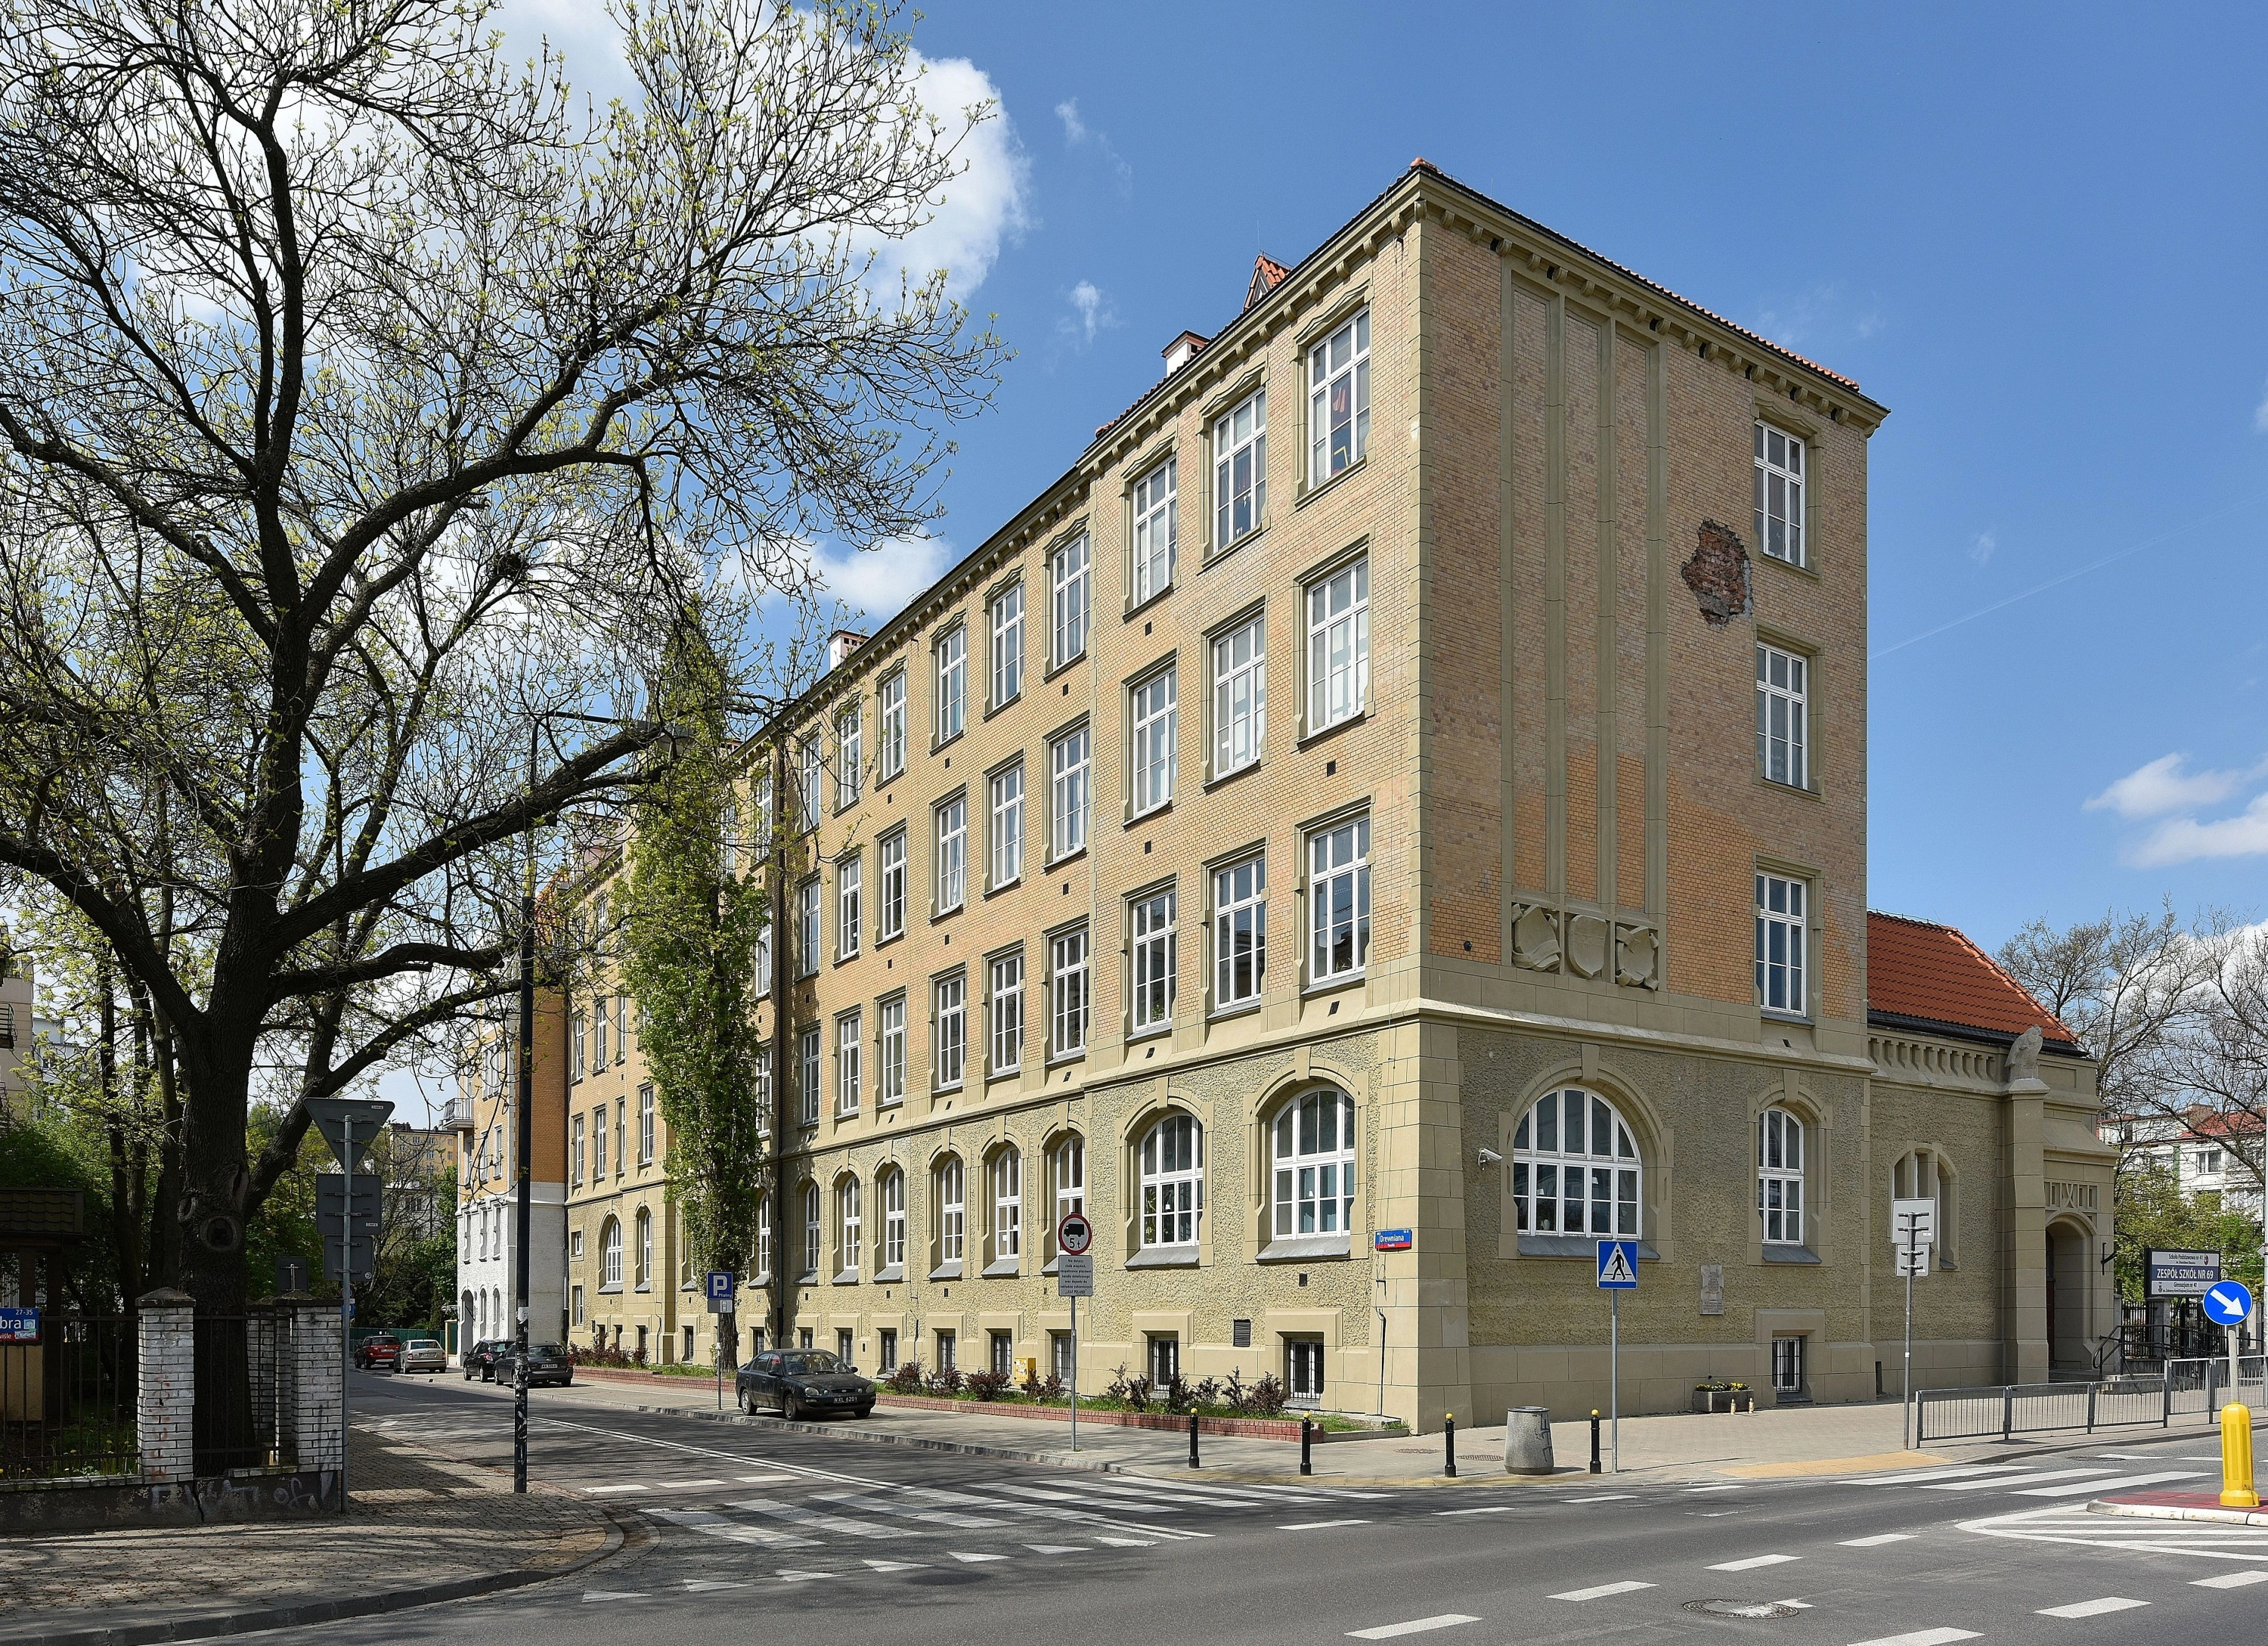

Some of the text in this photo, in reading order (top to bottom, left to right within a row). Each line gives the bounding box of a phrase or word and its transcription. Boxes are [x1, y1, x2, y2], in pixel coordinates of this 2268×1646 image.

[1069, 1238, 1075, 1248] 5
[1380, 1234, 1404, 1242] Drewniana
[2157, 1267, 2214, 1279] ZESPÓŁ SZKÓŁ NR 69
[713, 1276, 727, 1296] P
